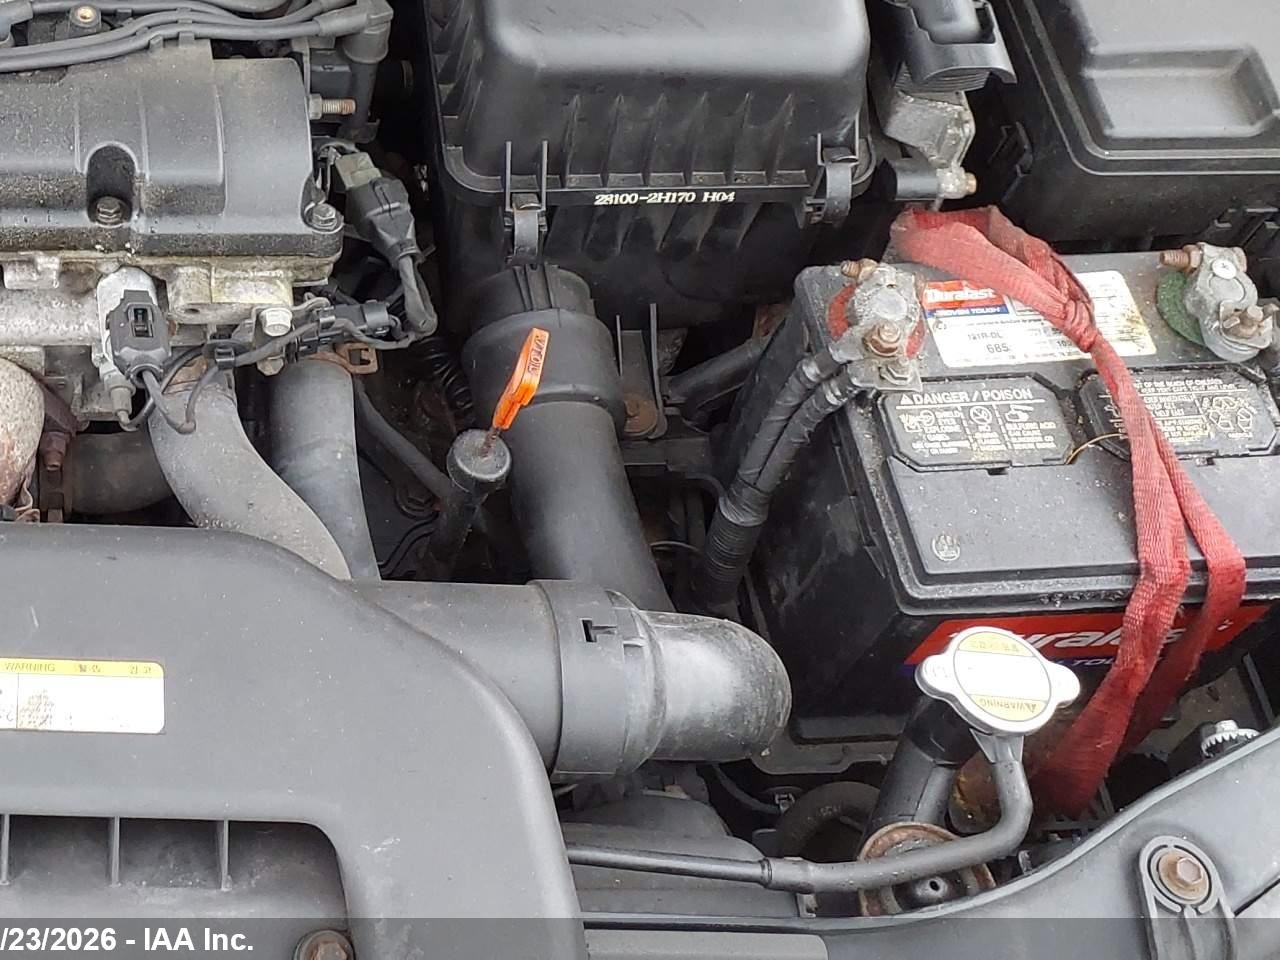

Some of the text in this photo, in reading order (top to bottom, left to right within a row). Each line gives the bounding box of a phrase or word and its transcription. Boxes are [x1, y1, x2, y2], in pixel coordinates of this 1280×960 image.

[702, 191, 736, 203] H04
[924, 287, 997, 303] Duralast
[913, 392, 970, 405] DANGER
[982, 388, 1033, 402] POISON
[5, 662, 56, 672] WARNING
[979, 698, 1027, 712] WARNING
